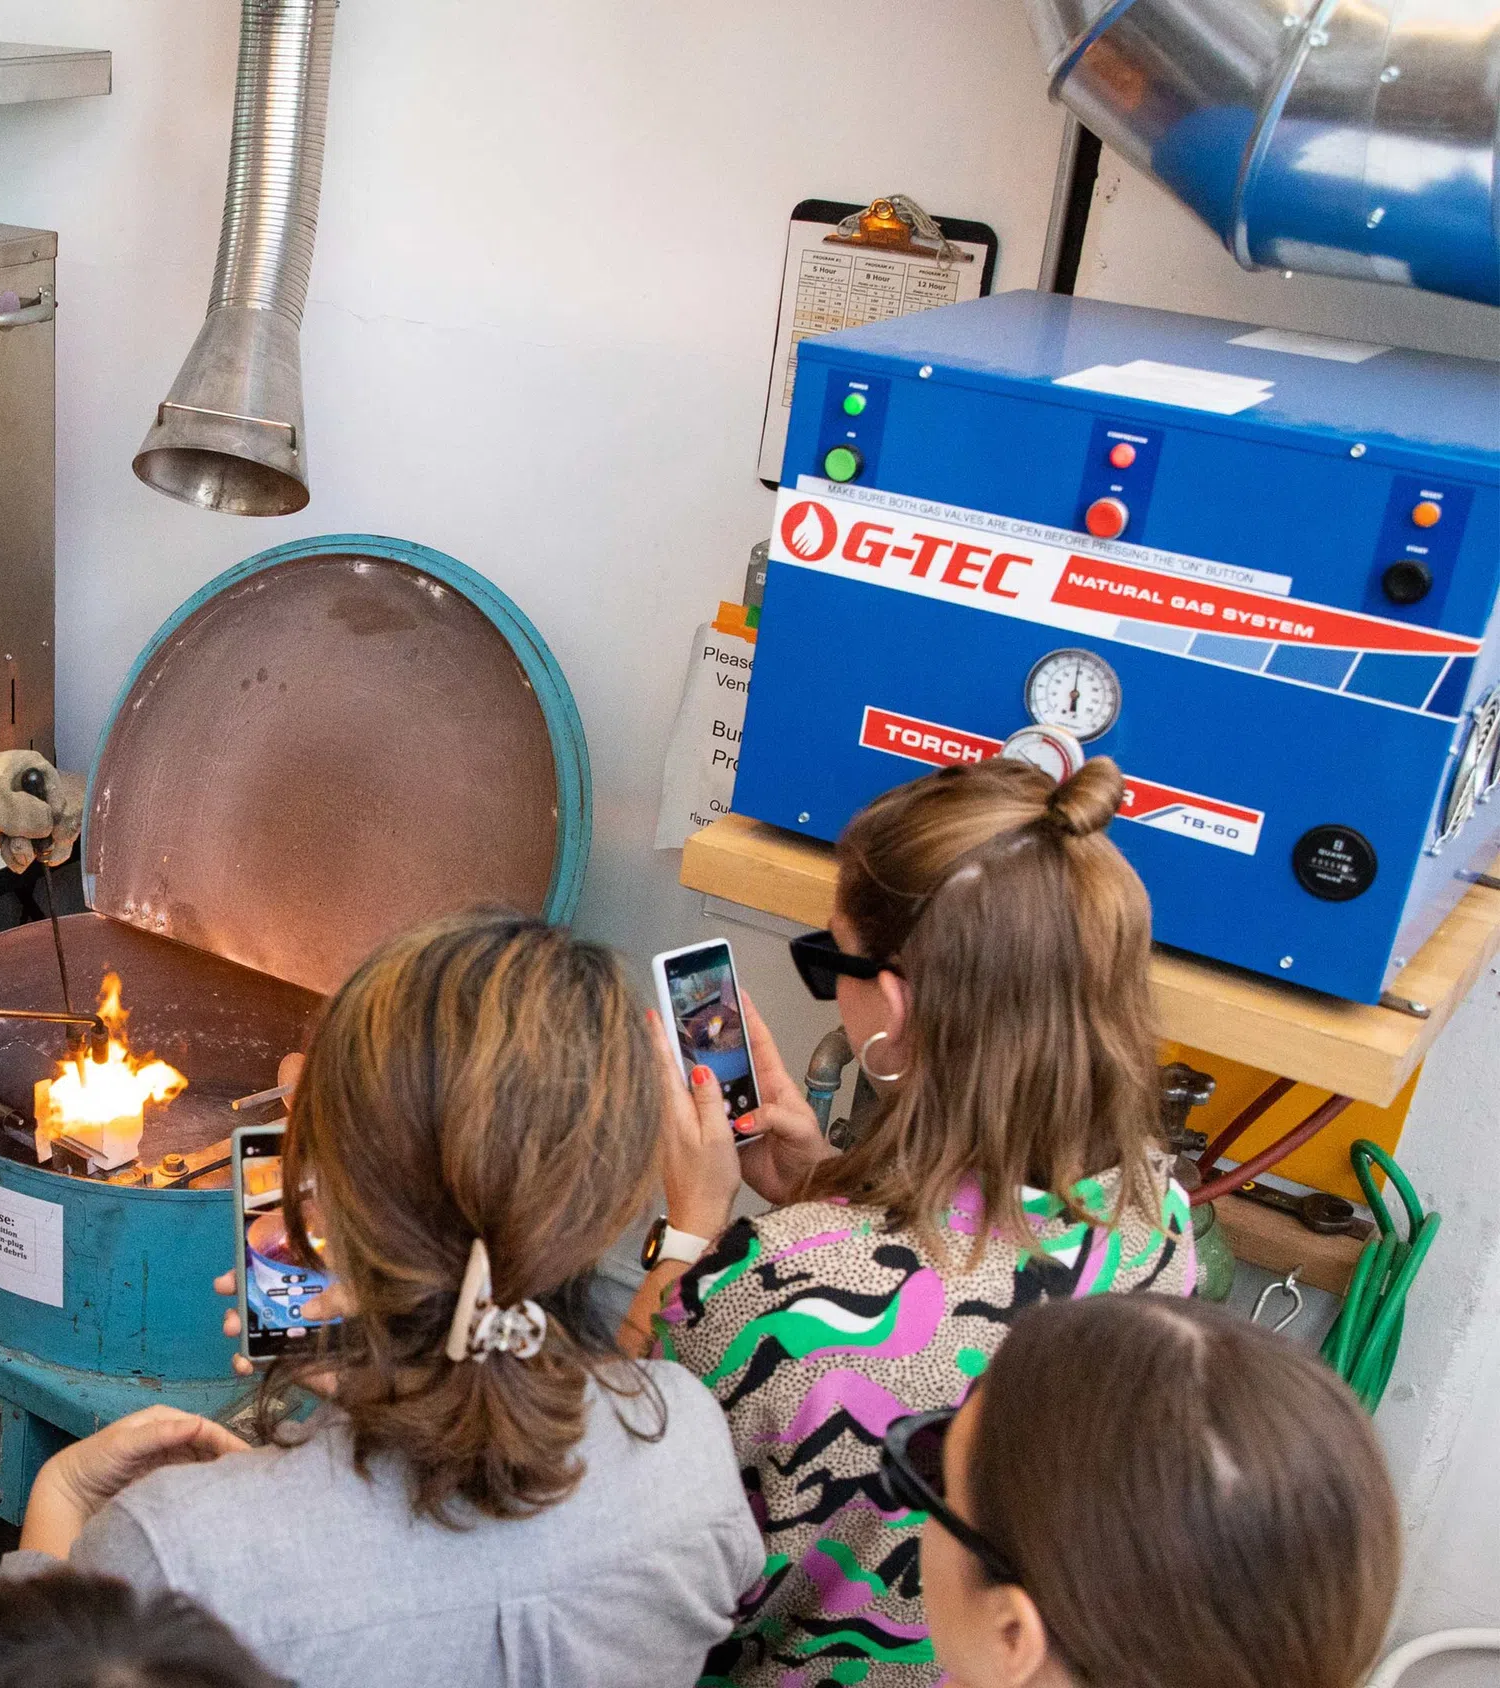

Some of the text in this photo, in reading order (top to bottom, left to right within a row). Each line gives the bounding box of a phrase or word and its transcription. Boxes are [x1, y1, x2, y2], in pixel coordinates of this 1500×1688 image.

[820, 267, 837, 275] Hour
[873, 274, 891, 283] Hour
[928, 283, 947, 291] Hour
[827, 485, 856, 499] MAKE
[858, 490, 886, 506] SURE
[889, 496, 917, 510] BOTH
[920, 502, 942, 517] GAS
[943, 508, 984, 526] VALVES
[987, 518, 1008, 532] ARE
[1011, 523, 1043, 538] OPEN
[1044, 530, 1090, 547] BEFORE
[1092, 539, 1149, 562] PRESSING
[1152, 553, 1177, 567] THE
[1205, 565, 1255, 584] BUTTON
[841, 520, 1034, 600] G-TEC
[1067, 572, 1316, 640] NATURAL GAS SYSTEM
[884, 723, 983, 764] TORCH
[1181, 814, 1240, 840] TB-60
[3, 1246, 27, 1260] debris
